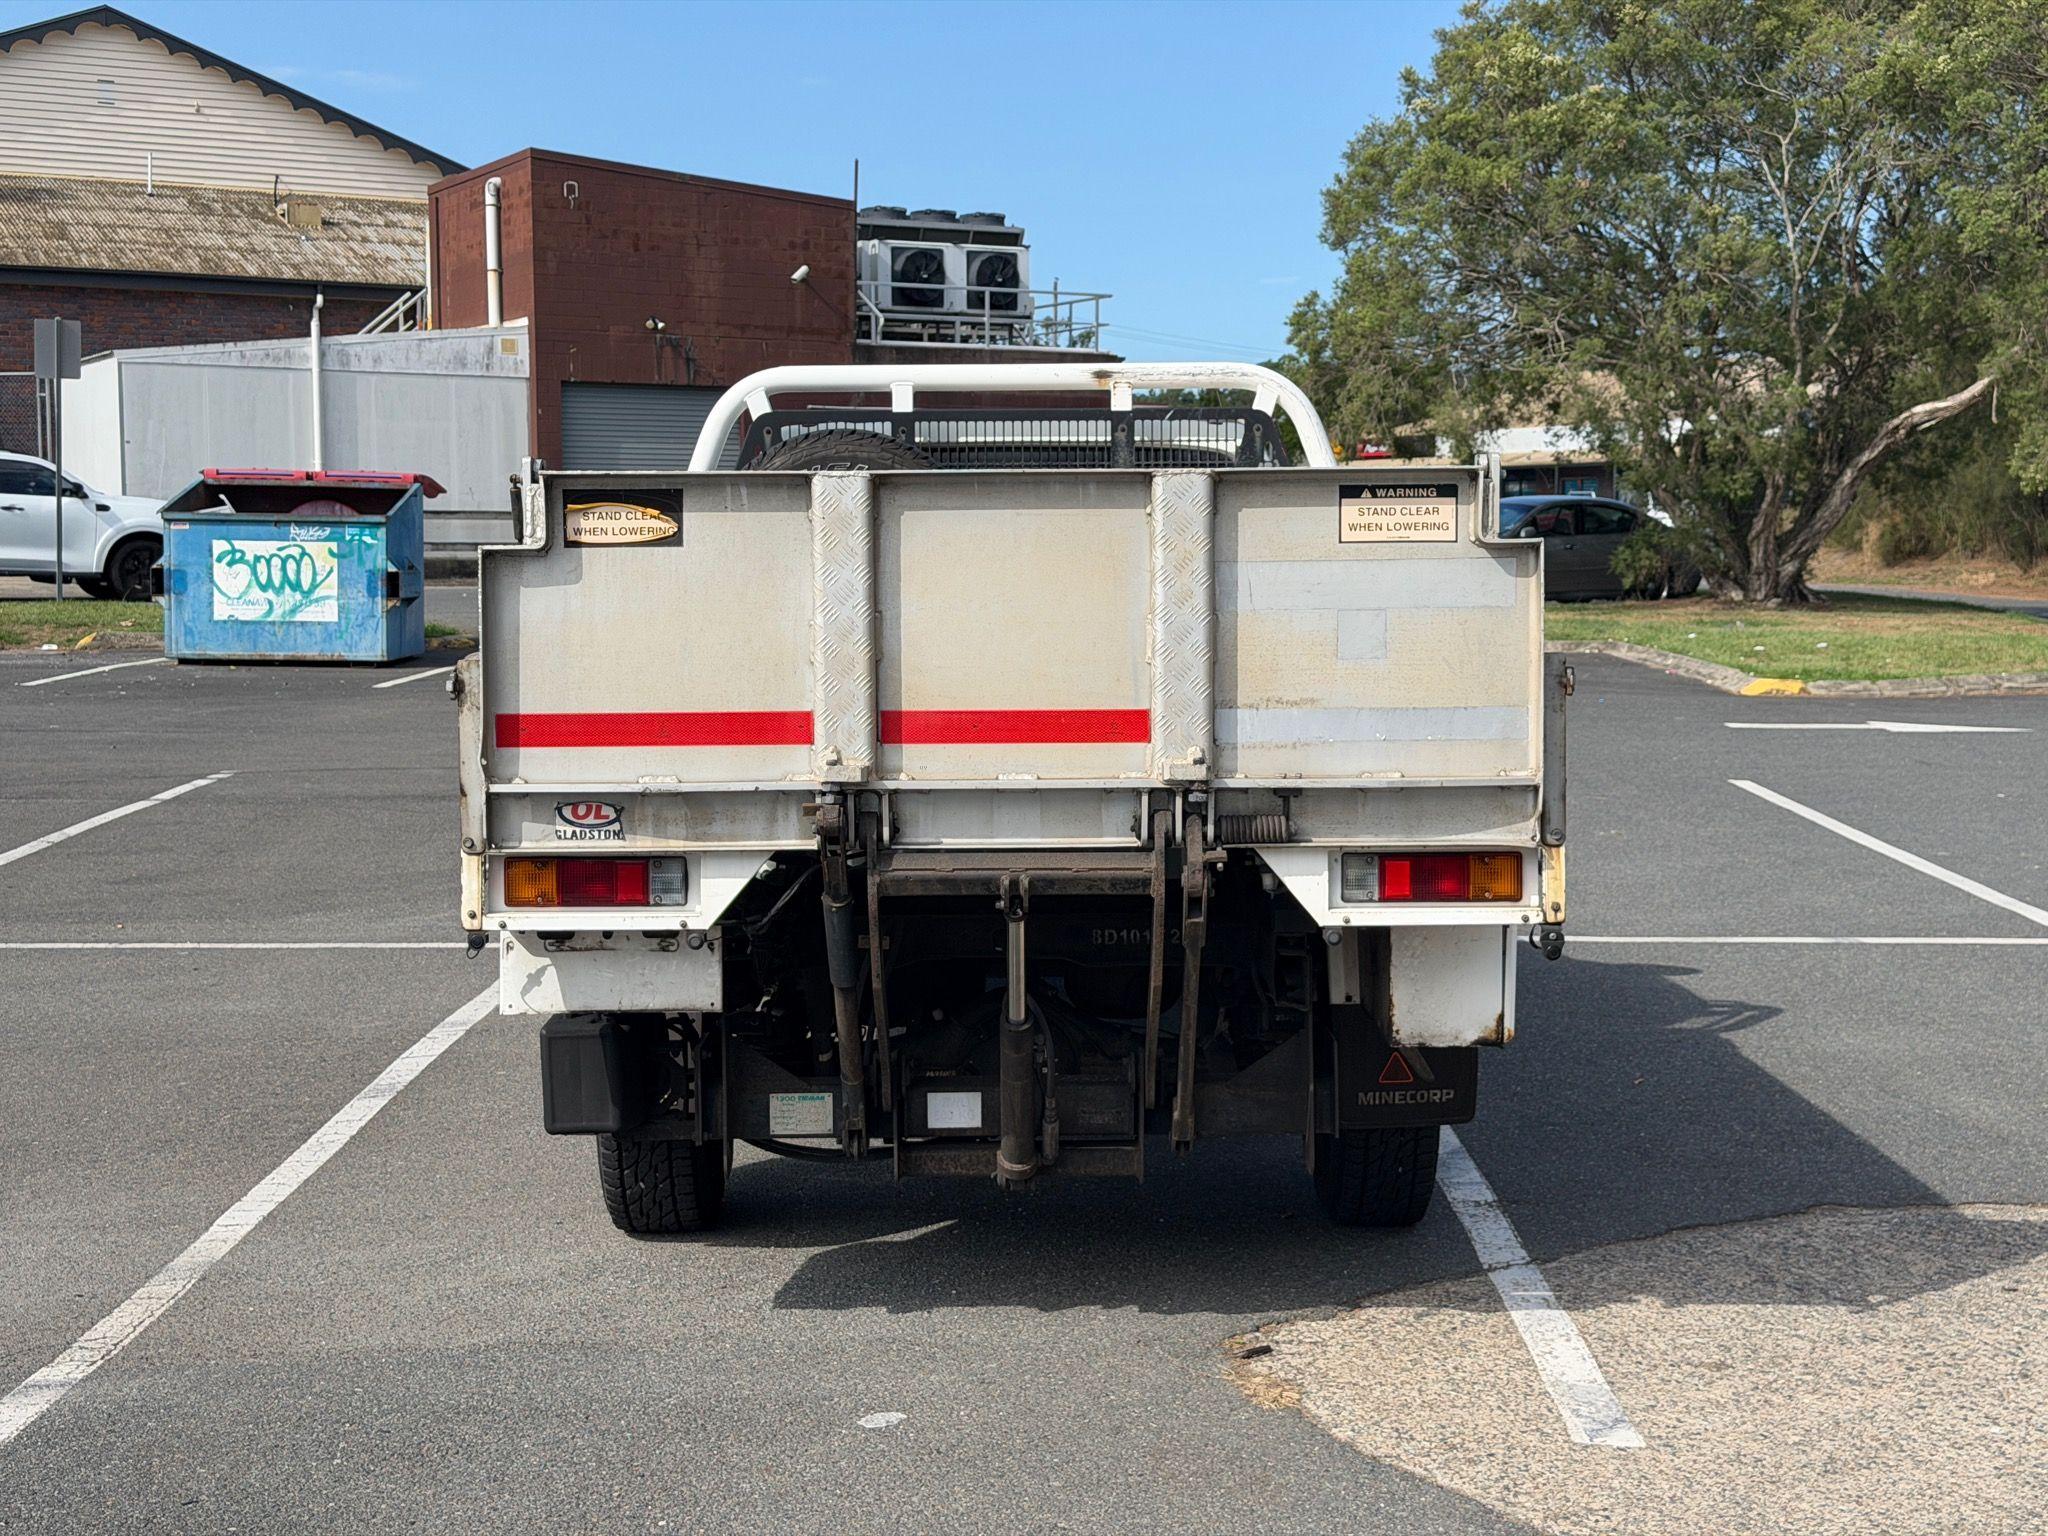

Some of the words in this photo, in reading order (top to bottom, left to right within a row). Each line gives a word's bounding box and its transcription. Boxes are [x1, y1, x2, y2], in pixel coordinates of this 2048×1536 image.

[1375, 488, 1437, 498] WARNING
[582, 511, 622, 521] STAND
[1358, 507, 1397, 517] STAND
[1400, 507, 1440, 516] CLEAR
[1348, 522, 1383, 532] WHEN
[1387, 521, 1449, 532] LOWERING
[573, 527, 608, 537] WHEN
[1358, 1089, 1455, 1106] MINECORP
